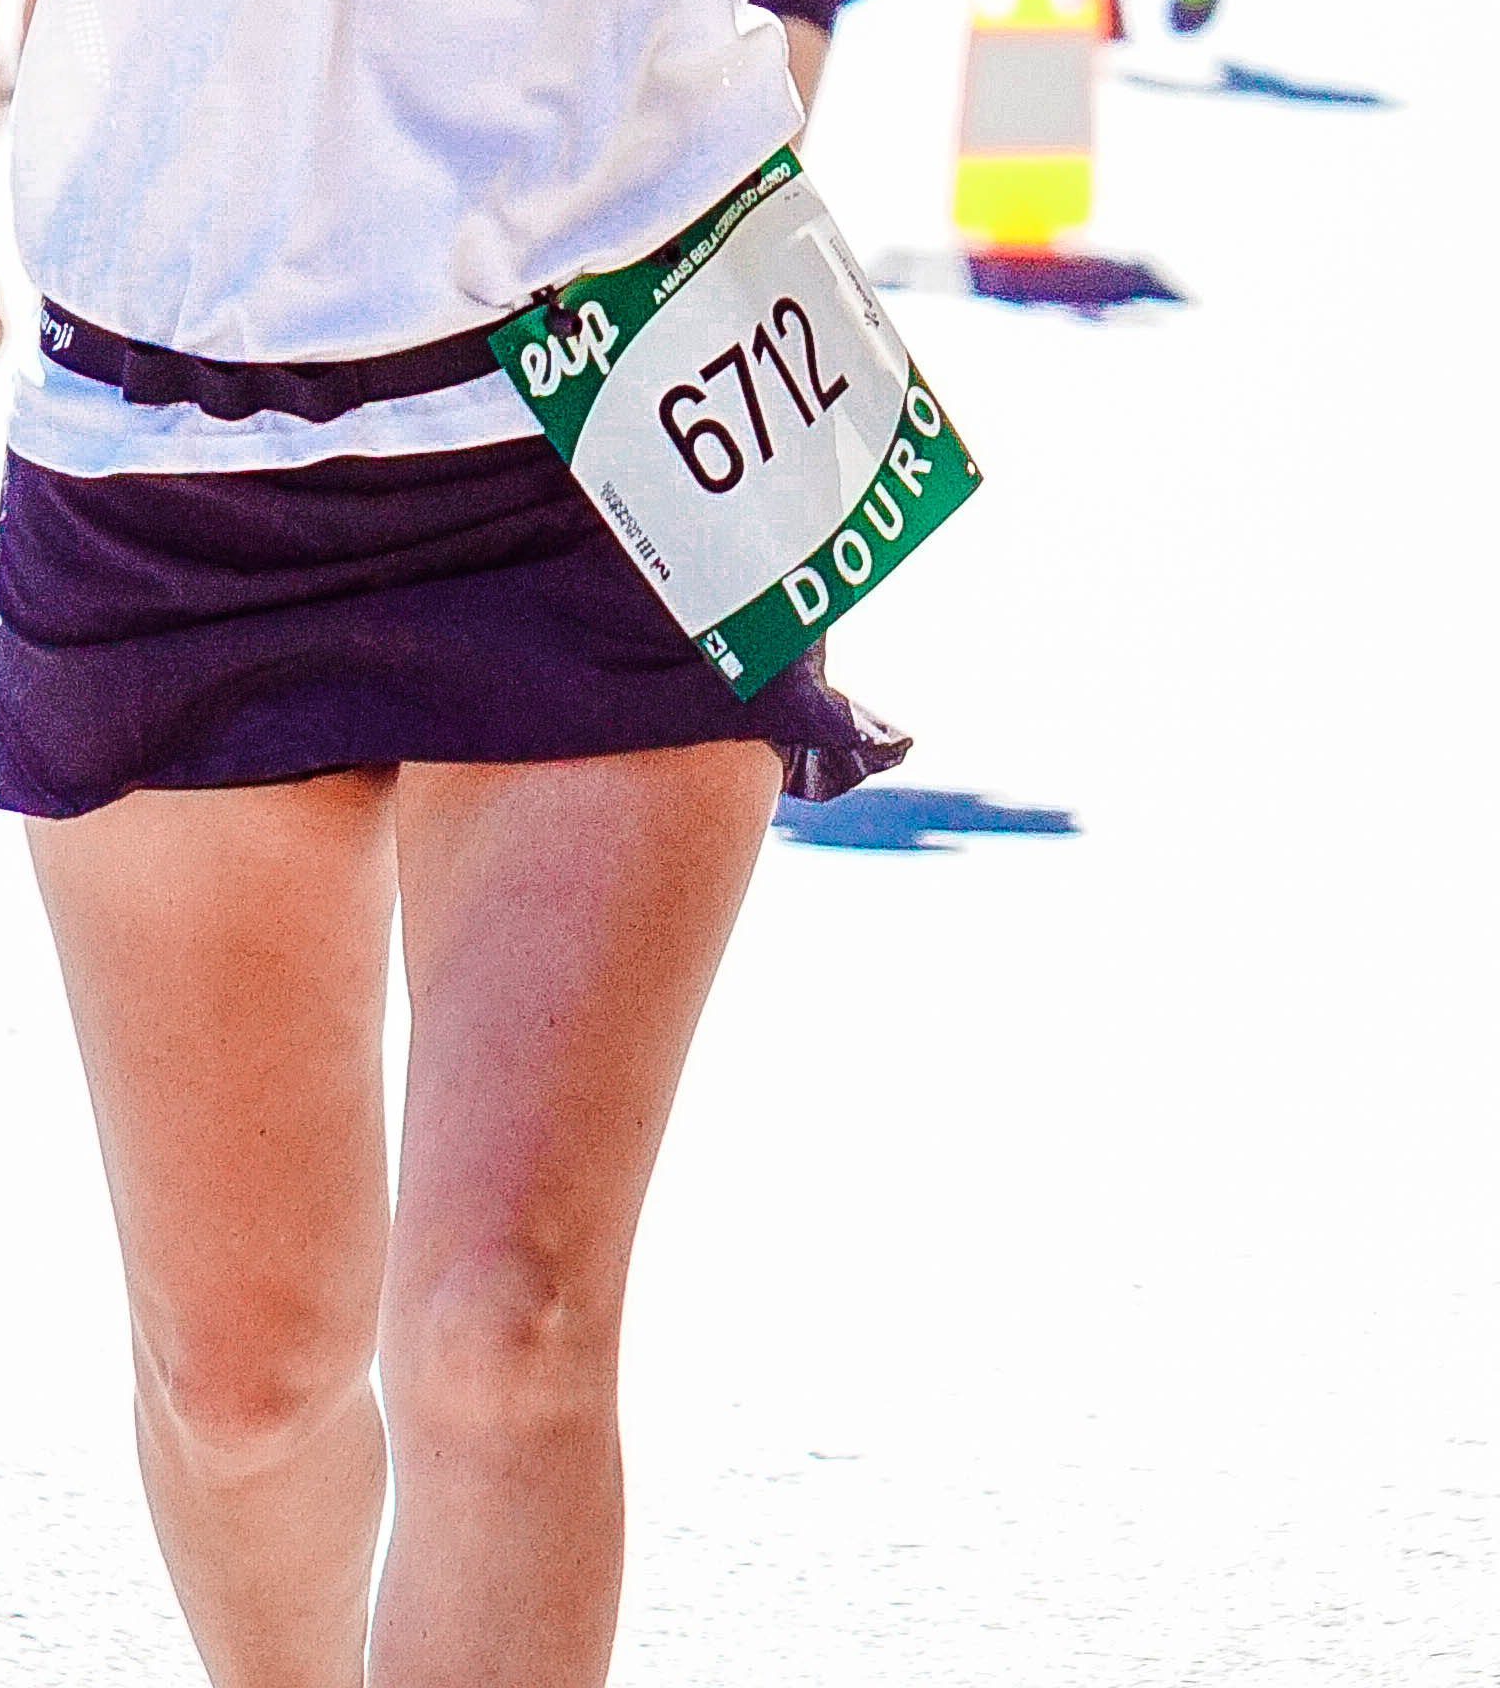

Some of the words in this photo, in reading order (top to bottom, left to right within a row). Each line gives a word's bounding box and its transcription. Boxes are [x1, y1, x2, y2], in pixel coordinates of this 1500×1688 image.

[653, 288, 667, 305] A
[661, 257, 693, 294] MAIS
[689, 231, 720, 265] BELA
[658, 296, 850, 495] 6712
[782, 386, 941, 626] DOURO
